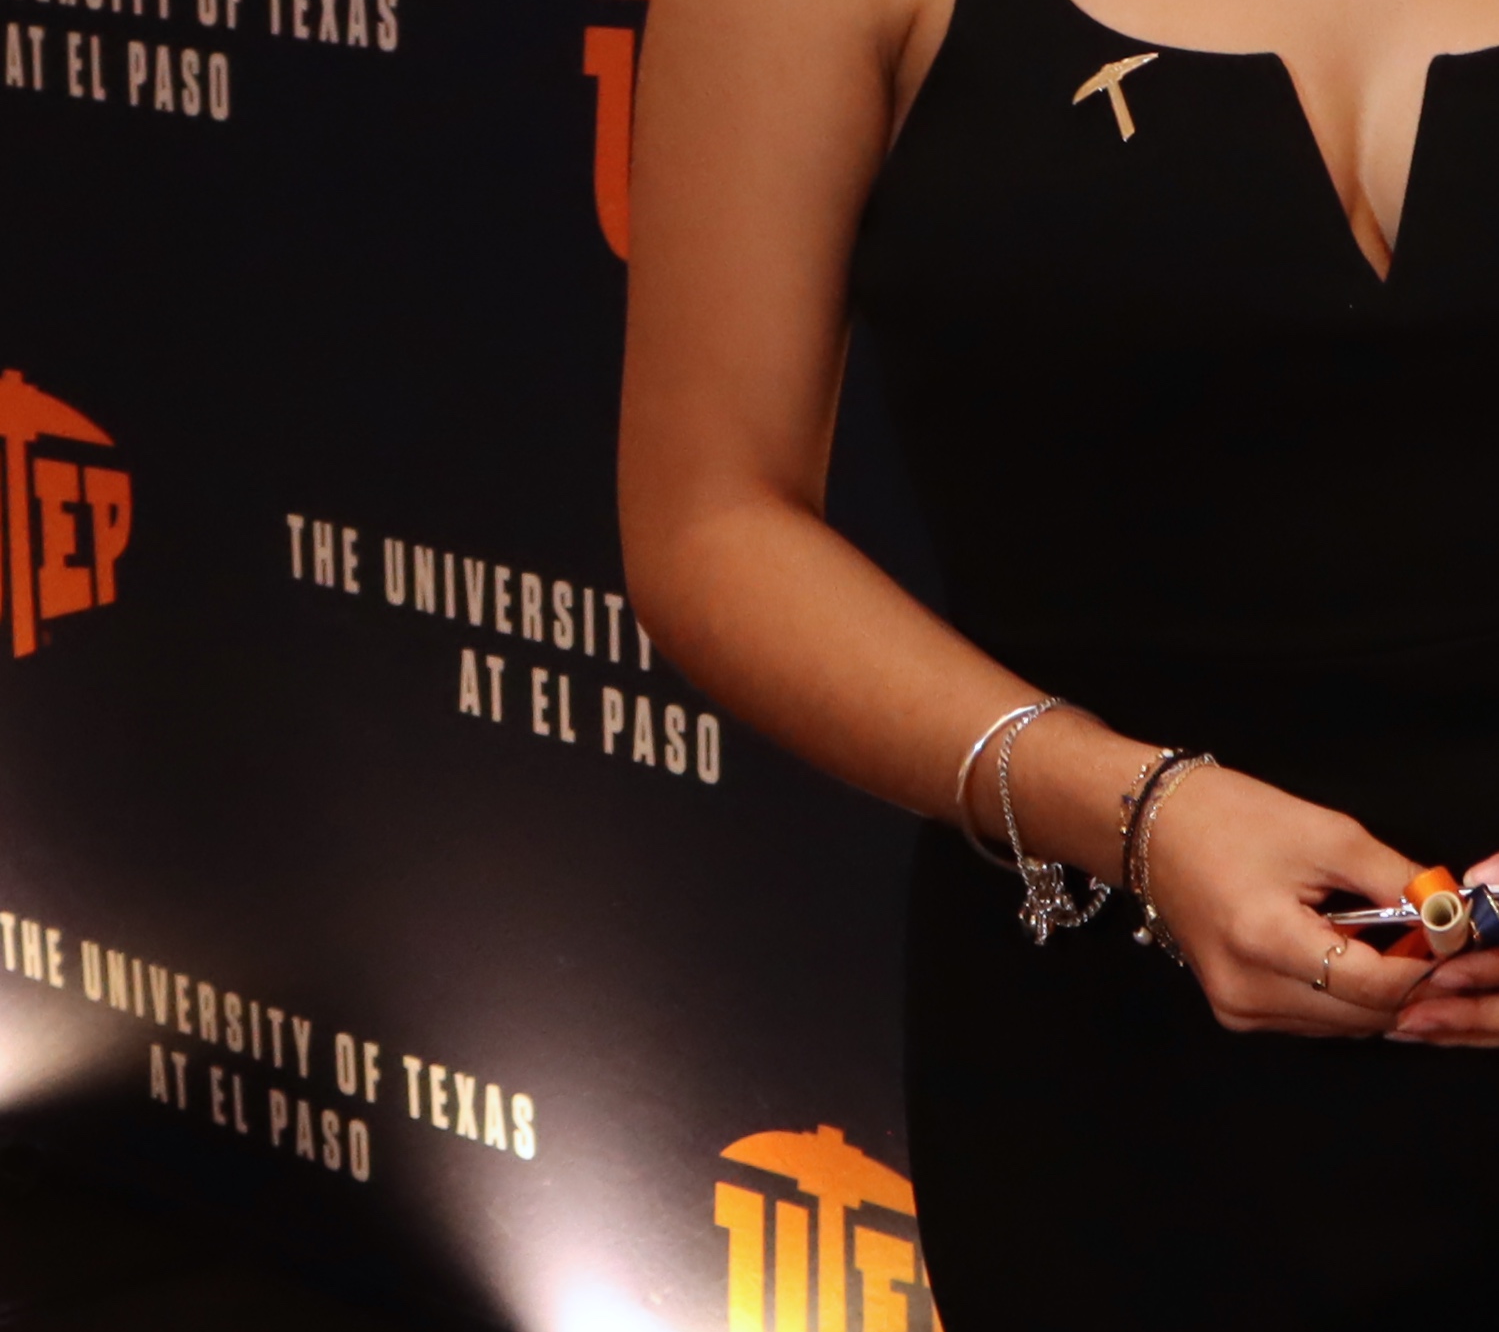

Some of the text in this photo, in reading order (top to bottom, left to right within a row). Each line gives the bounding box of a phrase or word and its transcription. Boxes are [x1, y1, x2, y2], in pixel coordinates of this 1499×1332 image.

[6, 22, 230, 122] AT EL PASO
[0, 369, 132, 658] TEP
[286, 513, 361, 595] THE
[459, 648, 721, 785] AT EL PASO
[0, 911, 538, 1163] THE UNIVERSITY OF TEXAS
[150, 1043, 371, 1184] AT EL PASO
